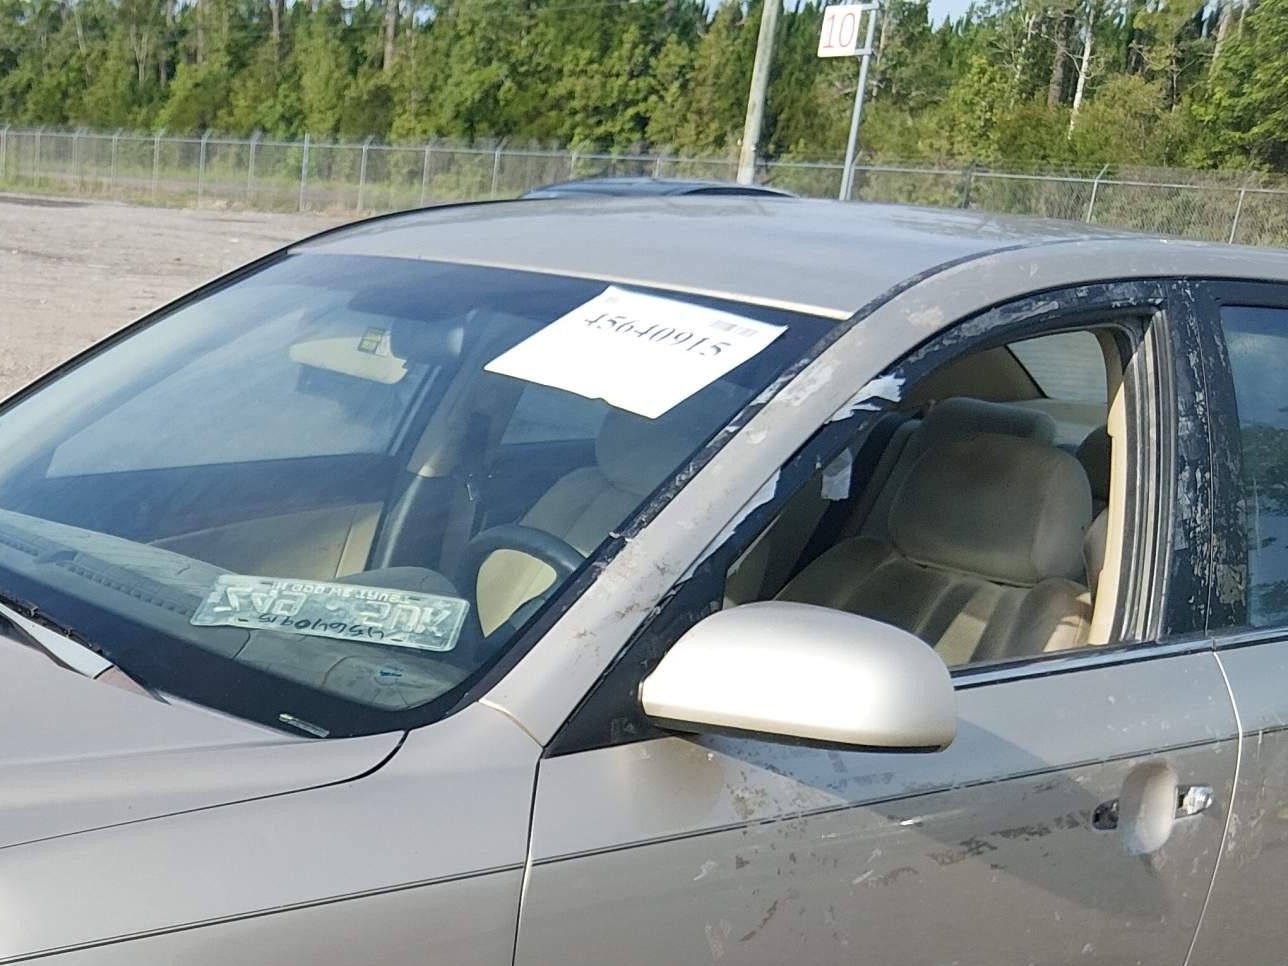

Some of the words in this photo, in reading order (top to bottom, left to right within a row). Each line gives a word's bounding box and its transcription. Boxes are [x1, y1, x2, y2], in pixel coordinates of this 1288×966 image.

[822, 12, 856, 49] 10
[584, 313, 732, 357] 45640915
[258, 613, 386, 639] 45640915
